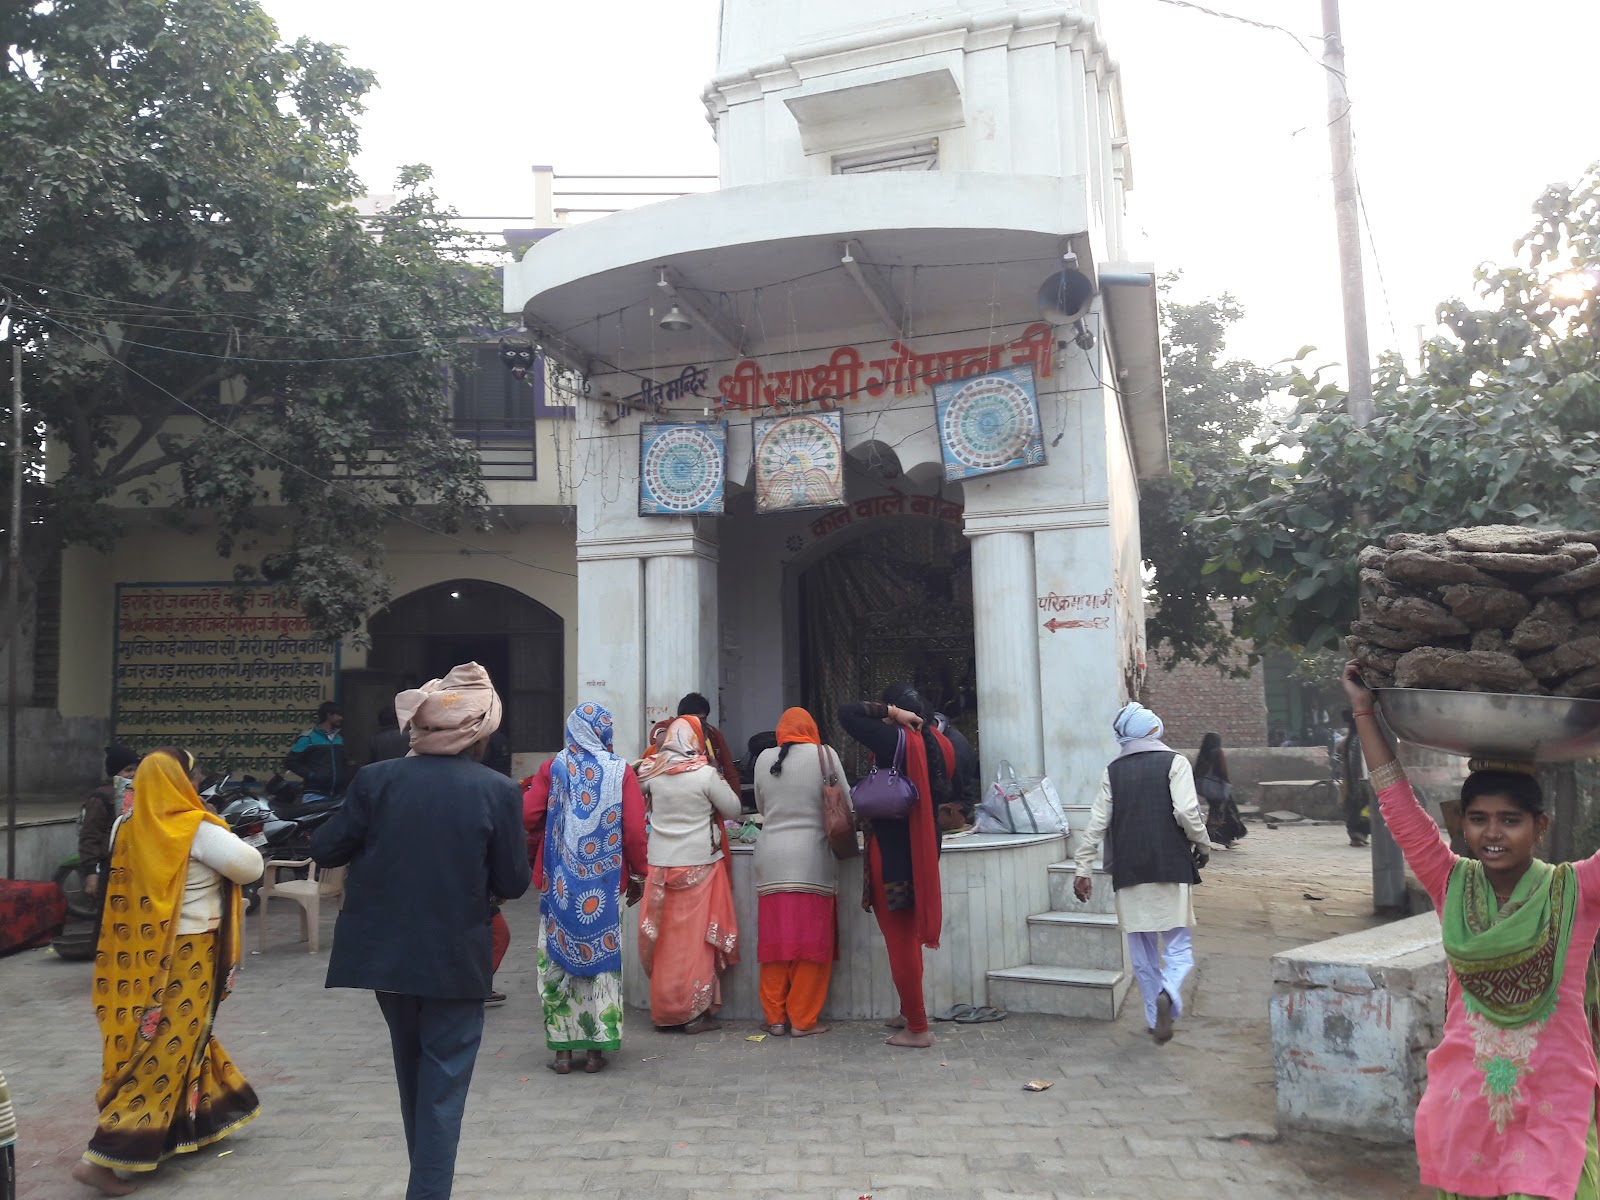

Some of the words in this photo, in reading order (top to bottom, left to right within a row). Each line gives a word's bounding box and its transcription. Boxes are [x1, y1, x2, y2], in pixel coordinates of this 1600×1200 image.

[666, 366, 709, 402] मन्दिर
[713, 359, 765, 414] श्री
[763, 347, 863, 411] साक्षी
[866, 340, 1000, 396] गोपाल
[853, 485, 906, 518] वाले
[120, 588, 151, 609] इरादे
[152, 588, 178, 609] रोज
[179, 588, 210, 609] बनते
[1038, 591, 1085, 612] परिक्रमा
[1085, 588, 1113, 610] मार्ग
[119, 635, 154, 660] मुक्ति
[177, 634, 218, 655] गोपाल
[239, 634, 263, 656] मेरी
[264, 634, 298, 659] मुक्ति
[176, 663, 218, 680] मस्तक
